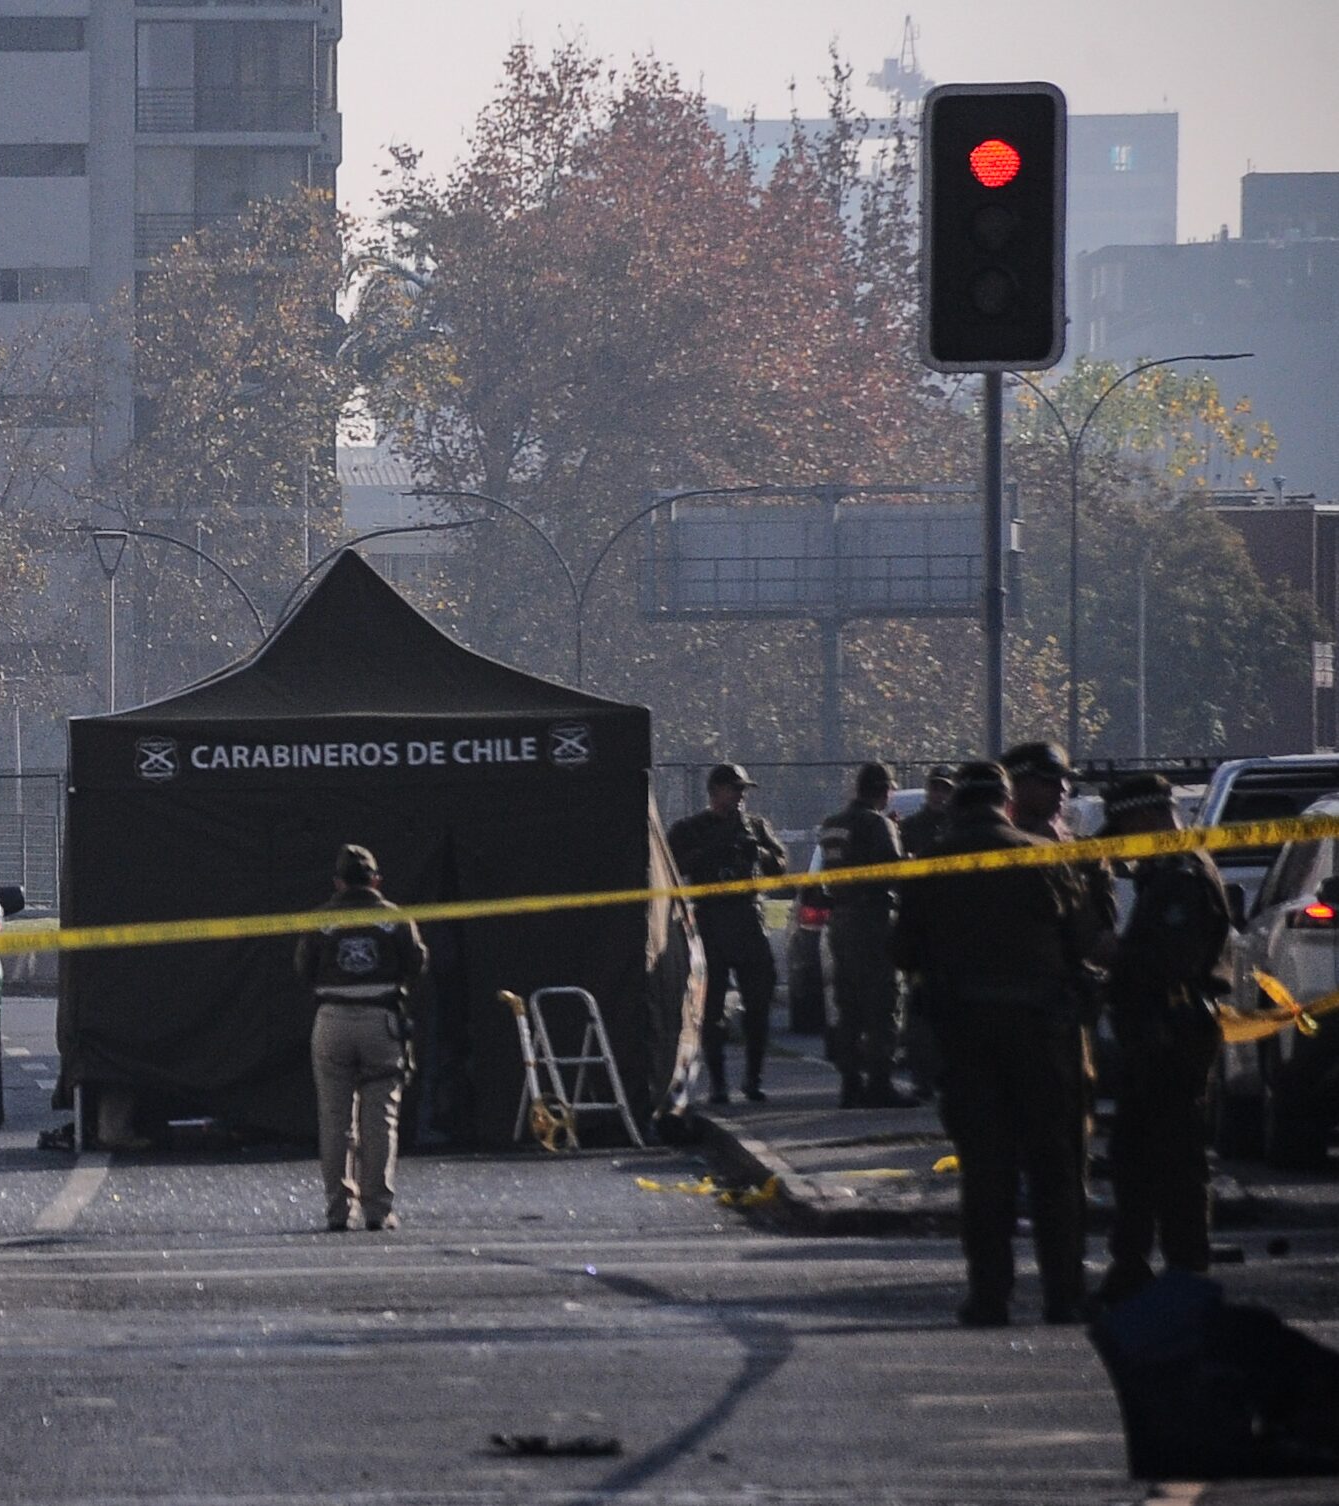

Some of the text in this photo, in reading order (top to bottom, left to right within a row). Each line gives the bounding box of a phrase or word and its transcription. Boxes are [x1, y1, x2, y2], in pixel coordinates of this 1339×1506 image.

[190, 737, 538, 770] CARABINEROS DE CHILE
